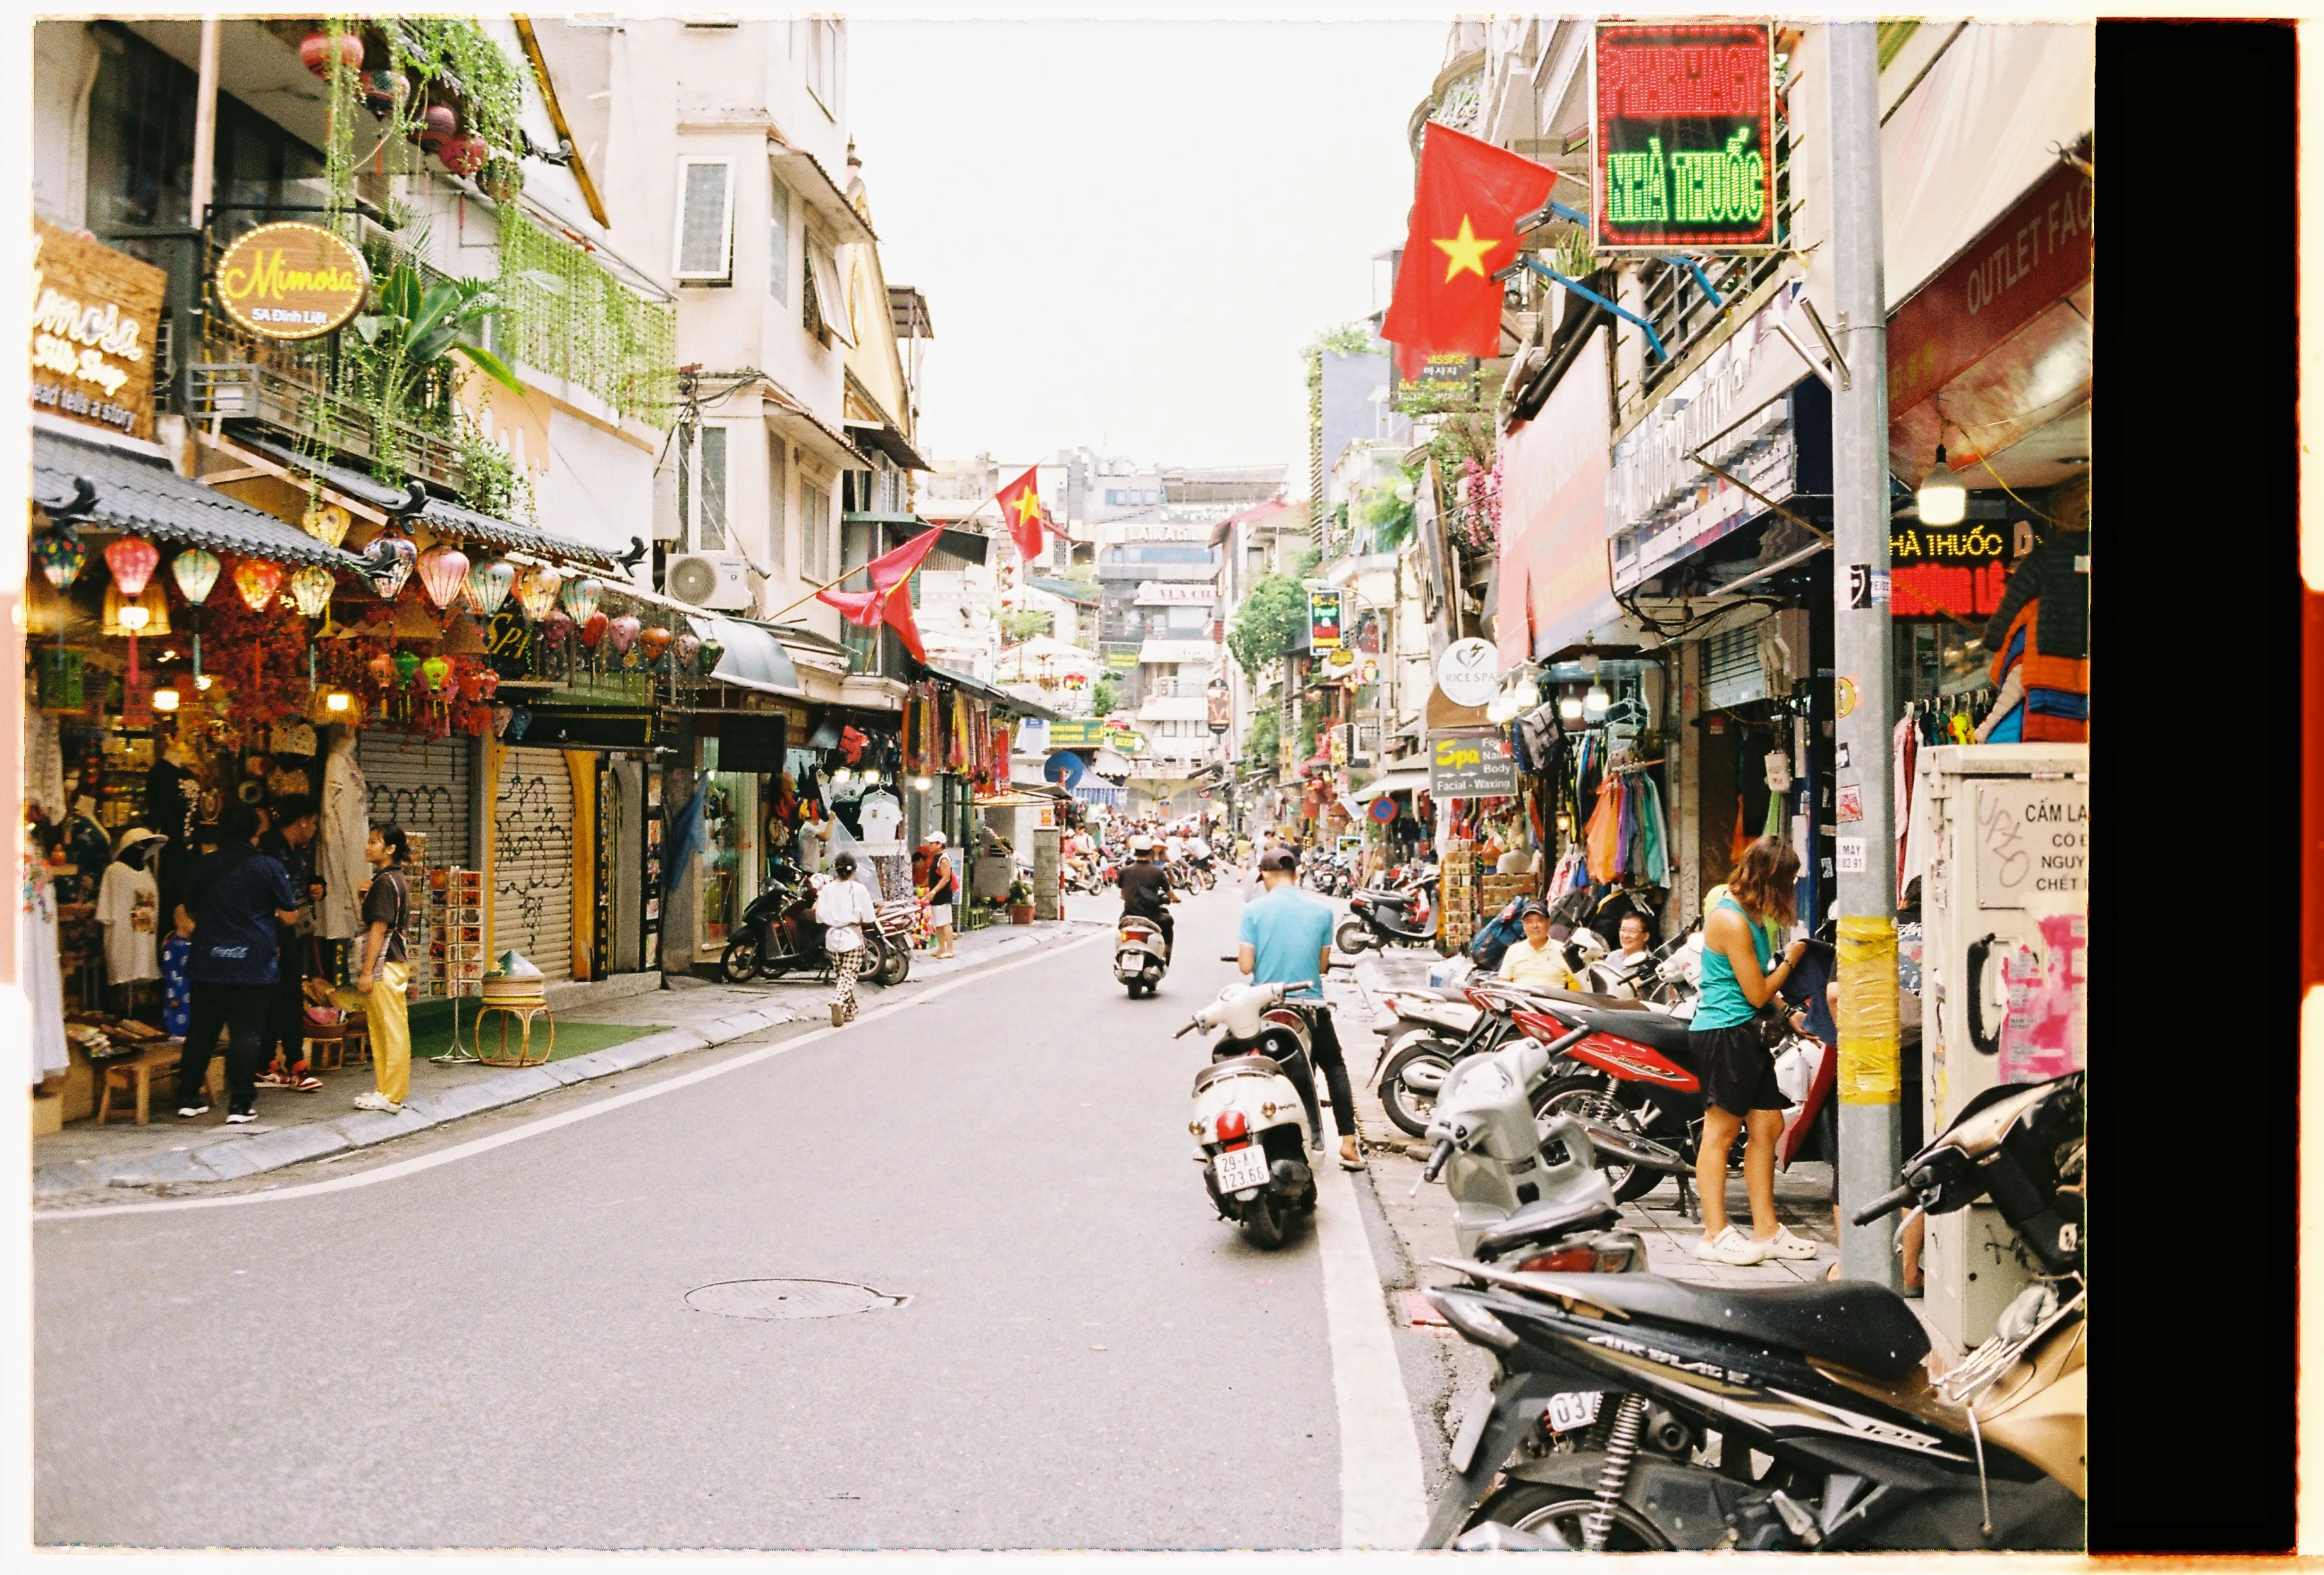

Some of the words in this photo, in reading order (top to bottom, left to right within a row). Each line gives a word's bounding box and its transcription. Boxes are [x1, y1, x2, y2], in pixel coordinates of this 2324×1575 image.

[224, 246, 356, 301] Mimosa
[1968, 214, 2042, 316] OUTLET
[90, 400, 101, 418] a
[101, 403, 137, 433] story
[1445, 672, 1470, 683] RICE
[1474, 672, 1496, 682] SPA
[1436, 739, 1481, 770] Spa
[1483, 764, 1511, 775] Body
[1437, 781, 1466, 791] Facial
[1474, 779, 1511, 790] Waxing
[2025, 797, 2062, 822] CẤM
[1842, 844, 1861, 856] MAY
[2052, 832, 2076, 847] CÓ
[2036, 873, 2078, 891] CHẾT
[1222, 1166, 1265, 1190] 123.66
